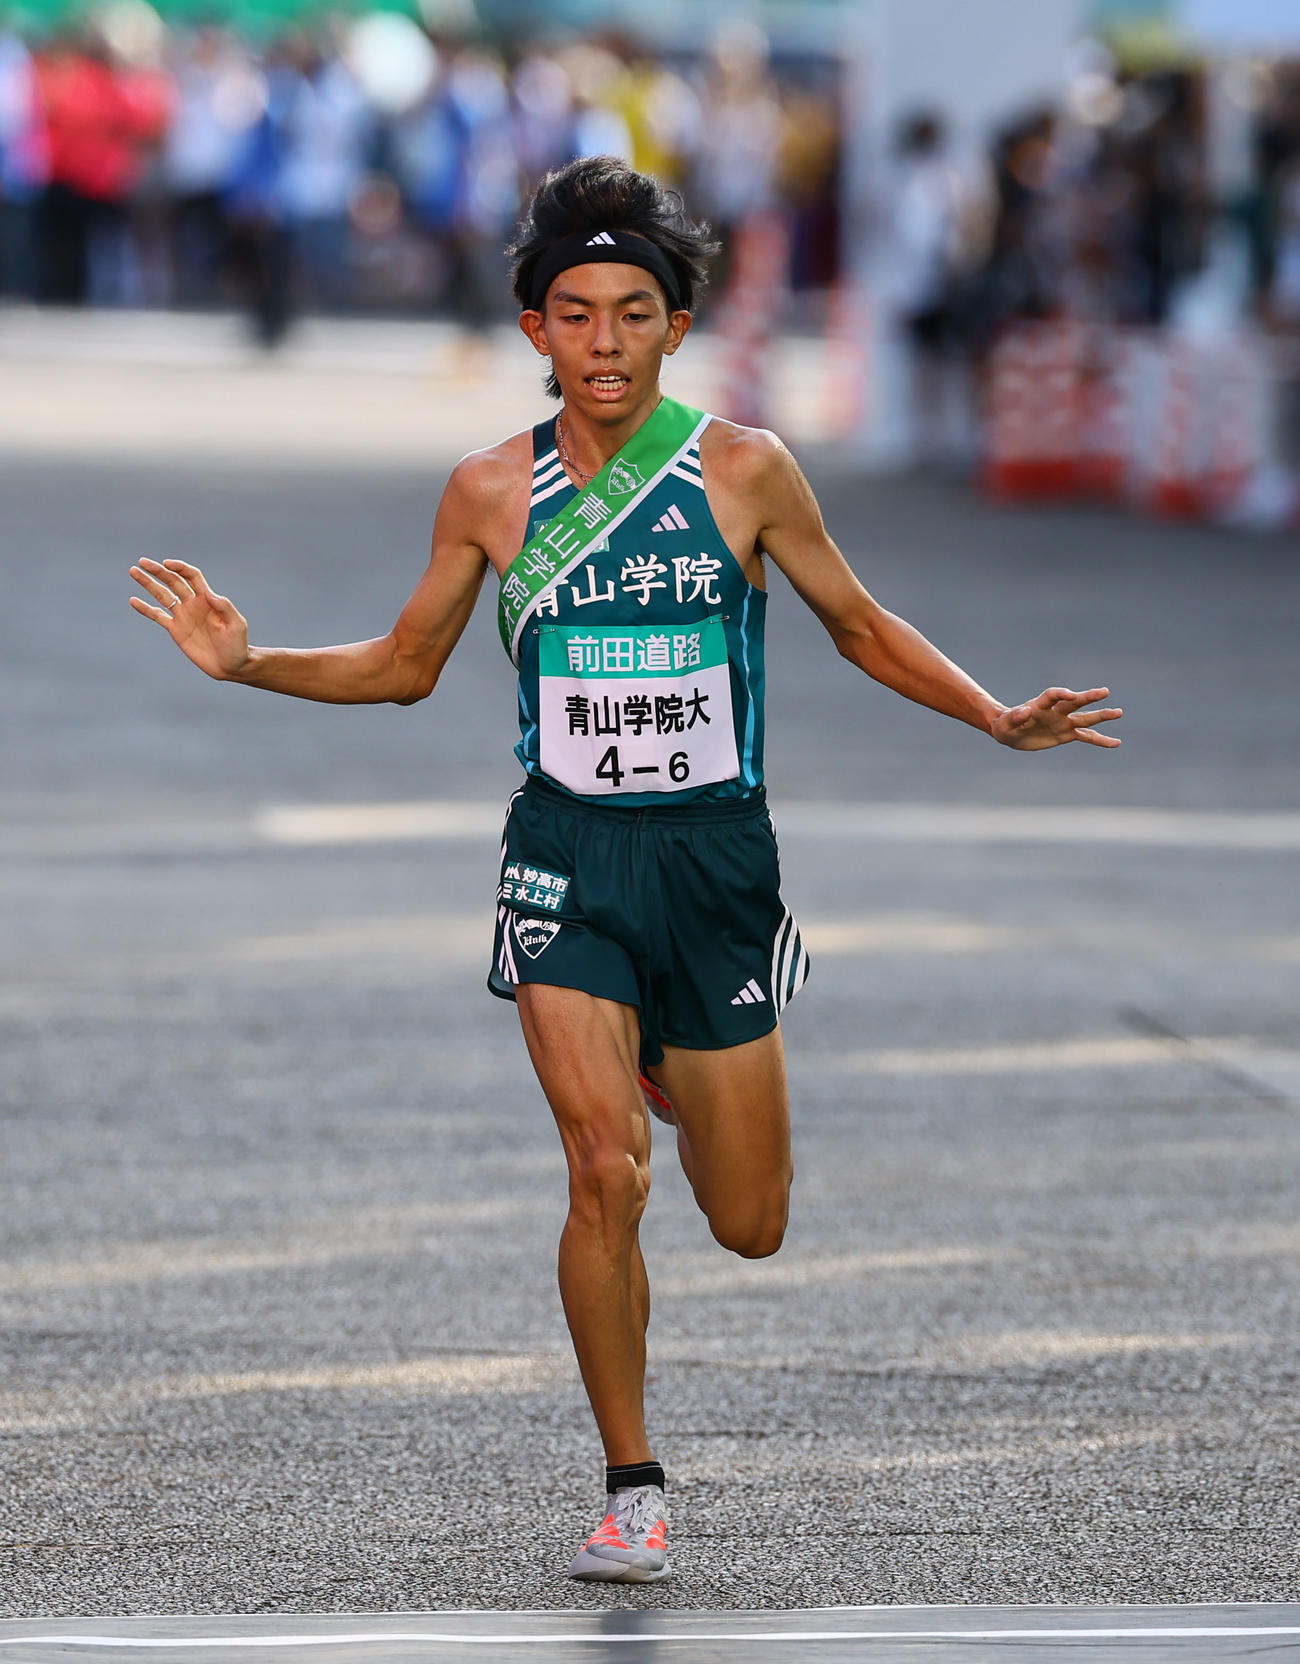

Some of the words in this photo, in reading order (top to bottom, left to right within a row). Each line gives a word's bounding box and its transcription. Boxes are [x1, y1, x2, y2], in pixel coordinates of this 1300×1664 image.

[566, 632, 700, 673] 前田道路
[564, 687, 711, 737] 青山学院大
[521, 867, 568, 893] 妙高市
[514, 885, 560, 910] 水上村
